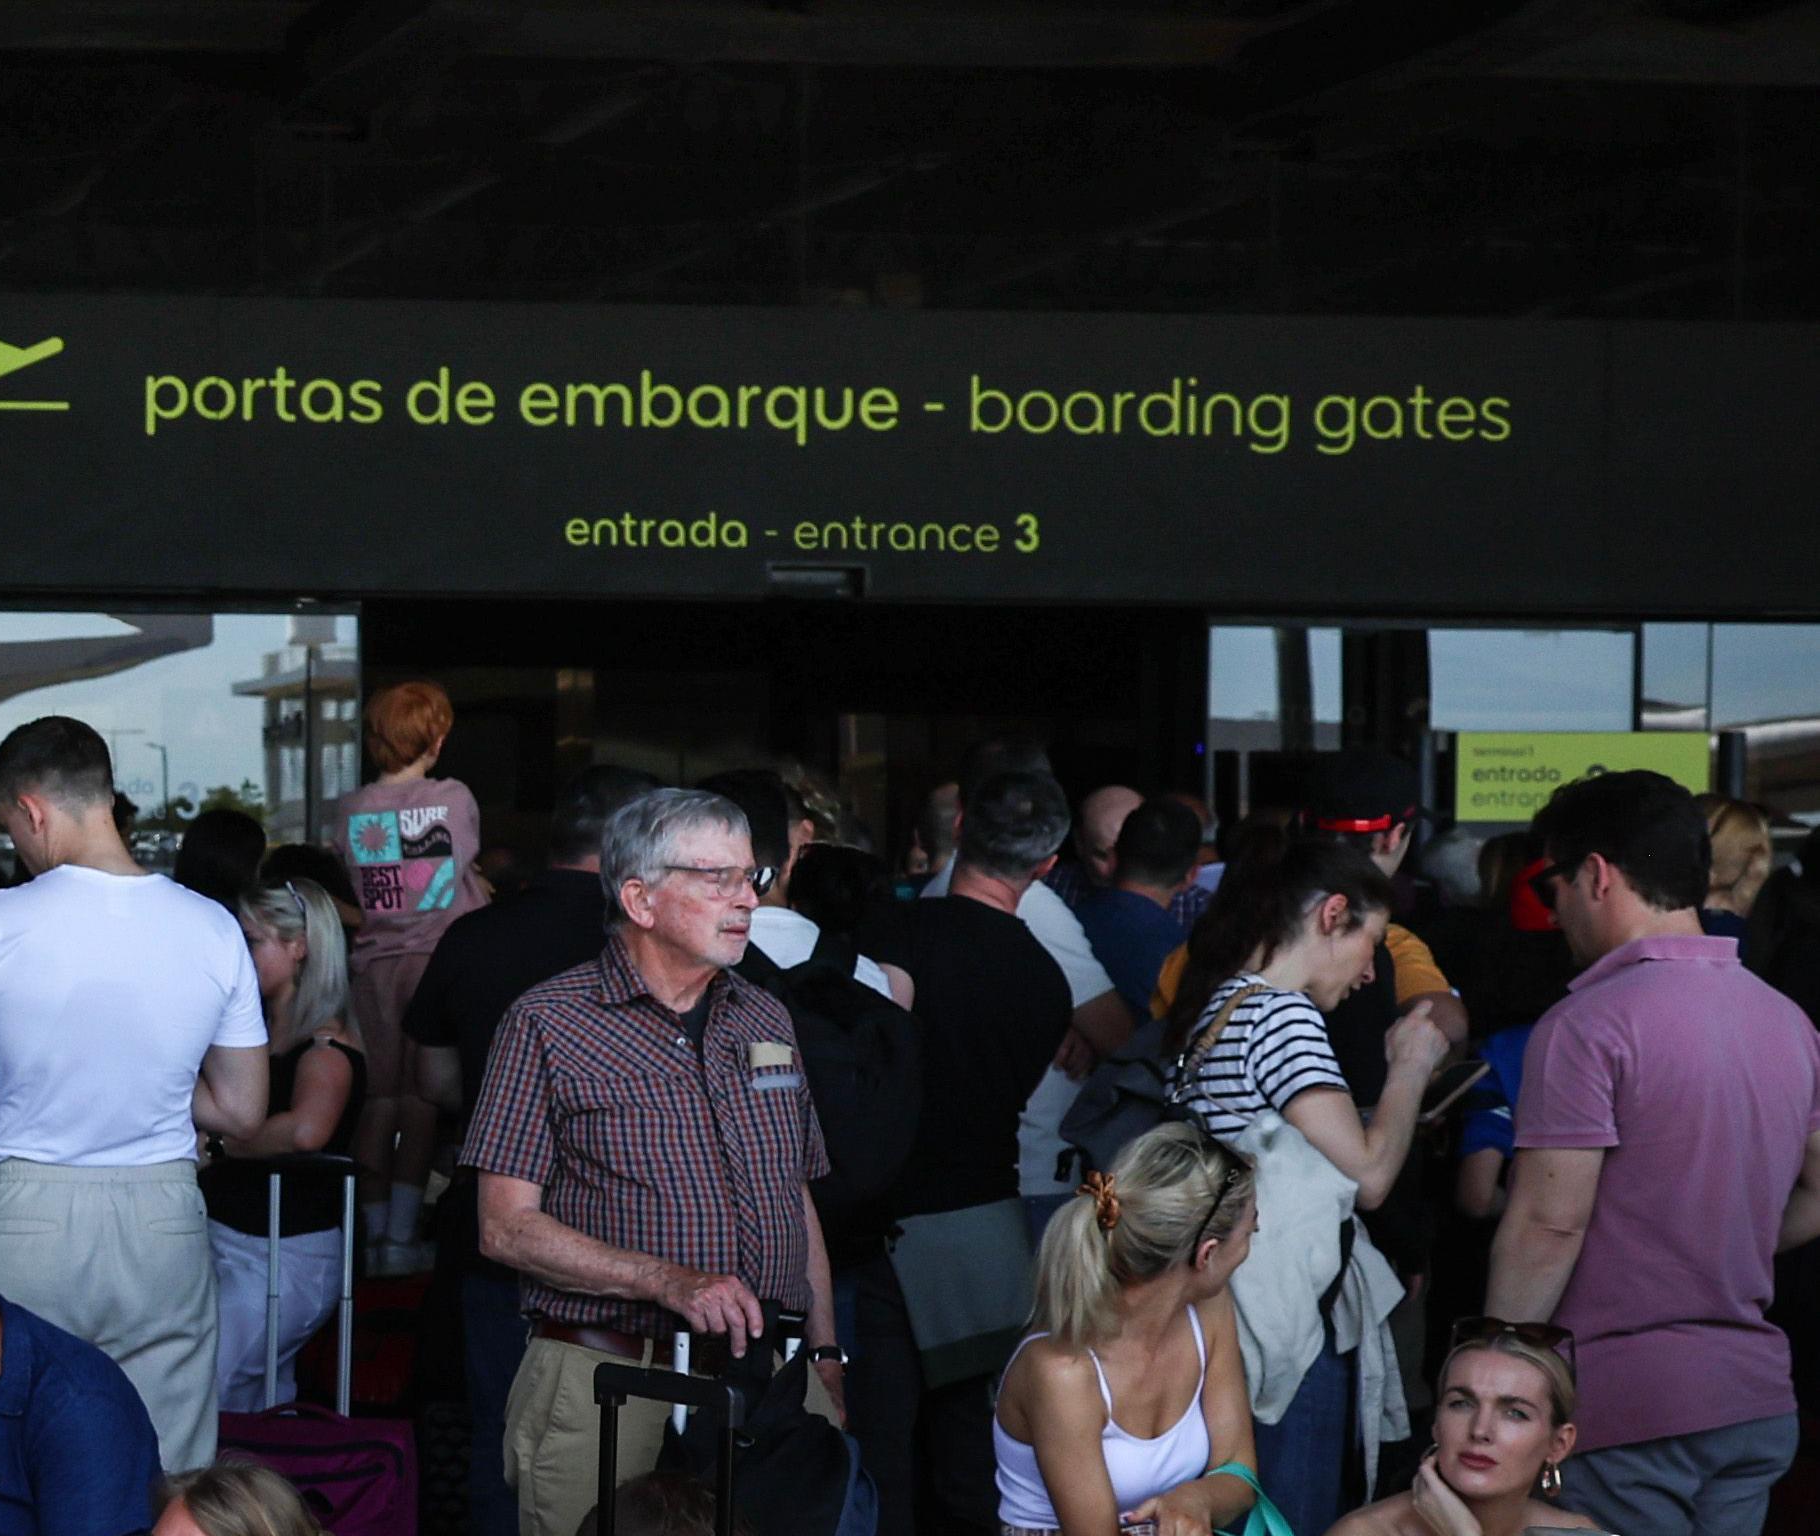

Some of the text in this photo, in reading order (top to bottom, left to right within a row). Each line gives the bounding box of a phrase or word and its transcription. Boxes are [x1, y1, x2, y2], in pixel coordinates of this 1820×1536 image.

[145, 366, 386, 436] portas
[407, 367, 499, 428] de
[519, 369, 902, 448] embarque
[971, 376, 1293, 455] boarding
[1315, 386, 1514, 457] gates
[566, 512, 751, 549] entrada
[793, 518, 1002, 554] entrance
[1014, 513, 1043, 554] 3
[1472, 765, 1561, 783] entrada
[400, 805, 449, 837] SURF
[360, 865, 402, 888] BEST
[362, 886, 404, 910] SPOT
